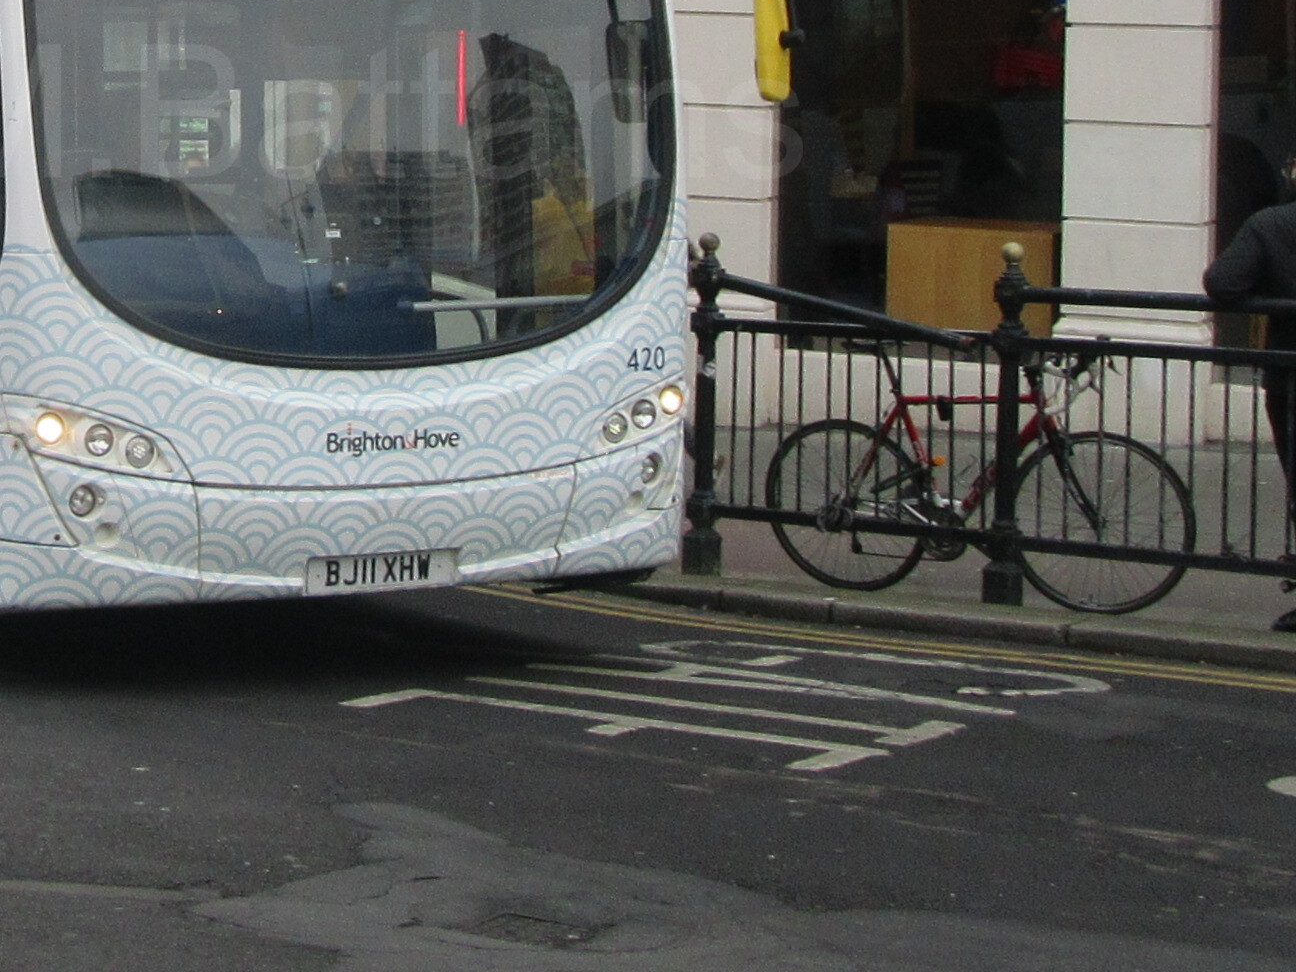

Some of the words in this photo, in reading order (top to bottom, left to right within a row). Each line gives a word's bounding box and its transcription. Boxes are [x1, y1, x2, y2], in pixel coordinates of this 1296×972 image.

[626, 345, 666, 372] 420
[324, 556, 376, 587] BJ11
[382, 553, 431, 583] XHW
